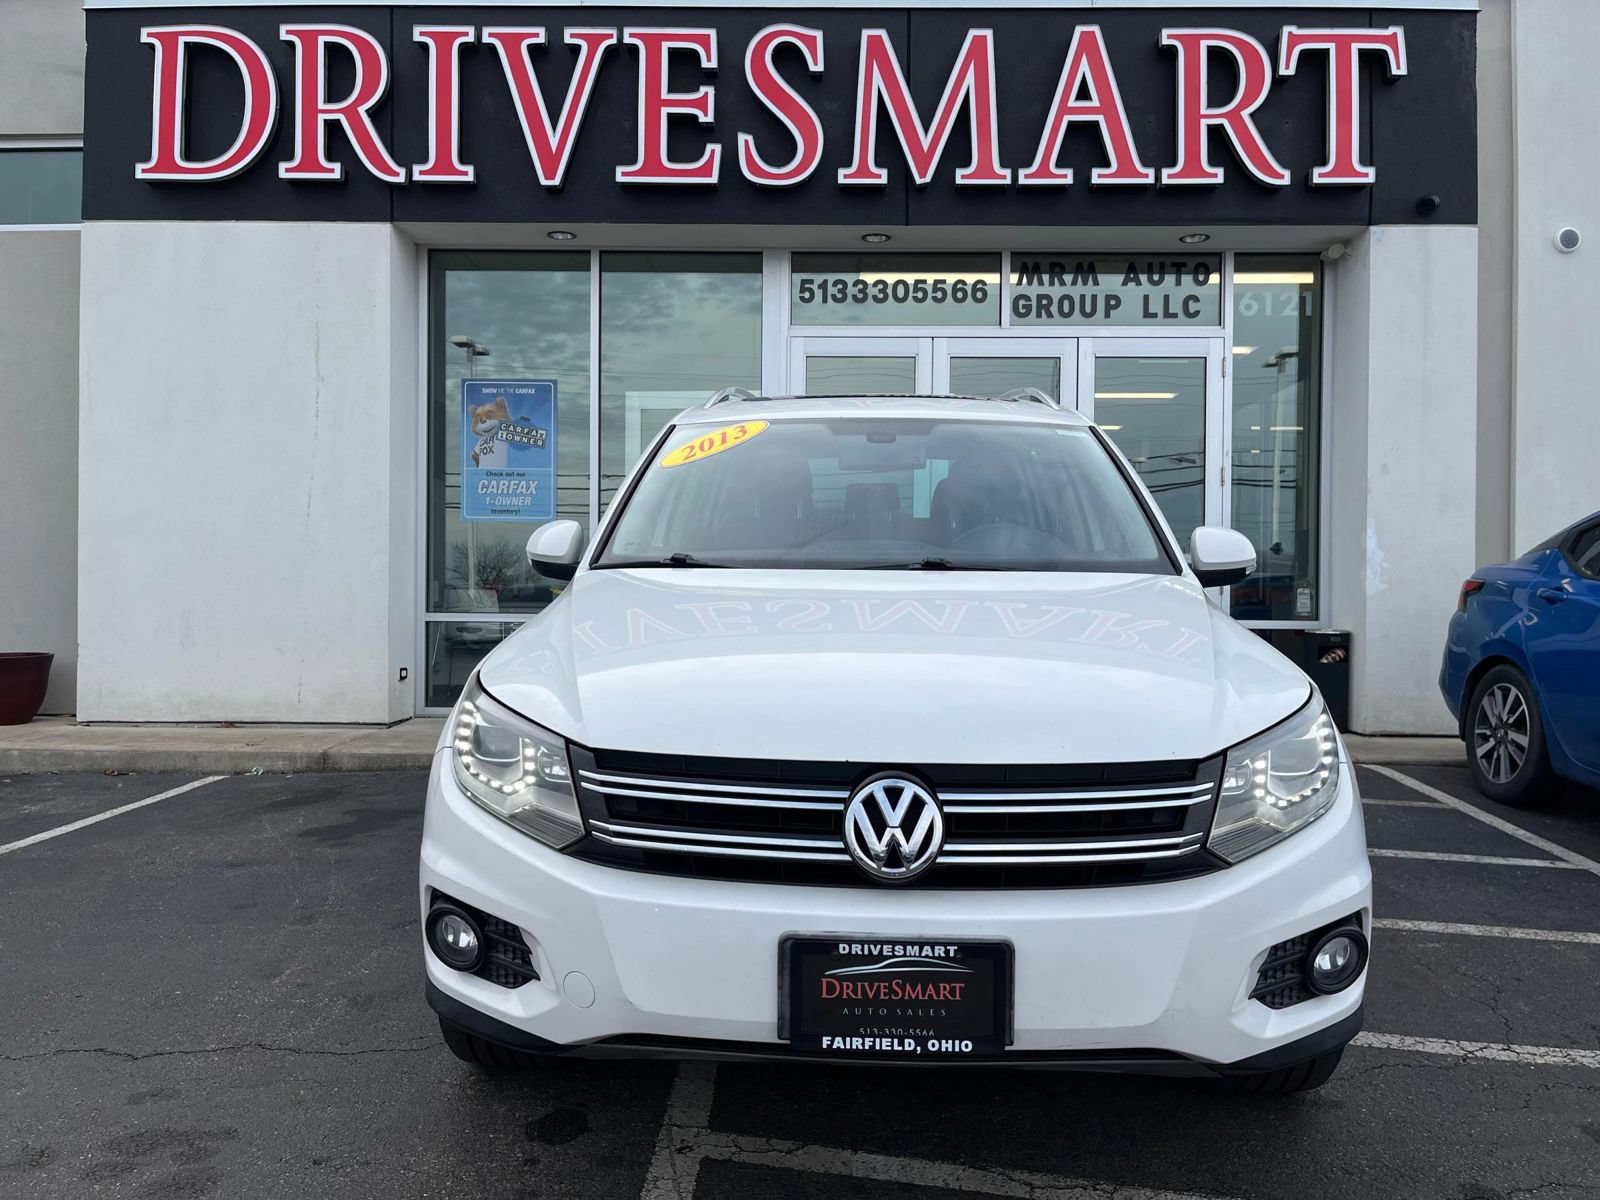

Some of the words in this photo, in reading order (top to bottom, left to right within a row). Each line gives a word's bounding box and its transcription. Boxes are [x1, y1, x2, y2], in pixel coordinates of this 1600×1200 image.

[135, 23, 1408, 187] DRIVESMART
[1015, 261, 1100, 287] MRM
[1121, 261, 1211, 287] AUTO
[799, 278, 988, 304] 5133305566
[1012, 293, 1122, 319] GROUP
[1143, 293, 1201, 319] LLC
[1239, 291, 1312, 316] 6121
[501, 424, 545, 439] CARFAX
[681, 425, 748, 460] 2013
[477, 479, 538, 494] CARFAX
[485, 496, 532, 506] 1-OWNER
[838, 943, 958, 957] DRIVESMART
[842, 1007, 888, 1016] AUTO
[896, 1007, 946, 1016] SALES
[822, 1036, 921, 1053] FAIRFIELD,
[928, 1039, 973, 1052] OHIO
